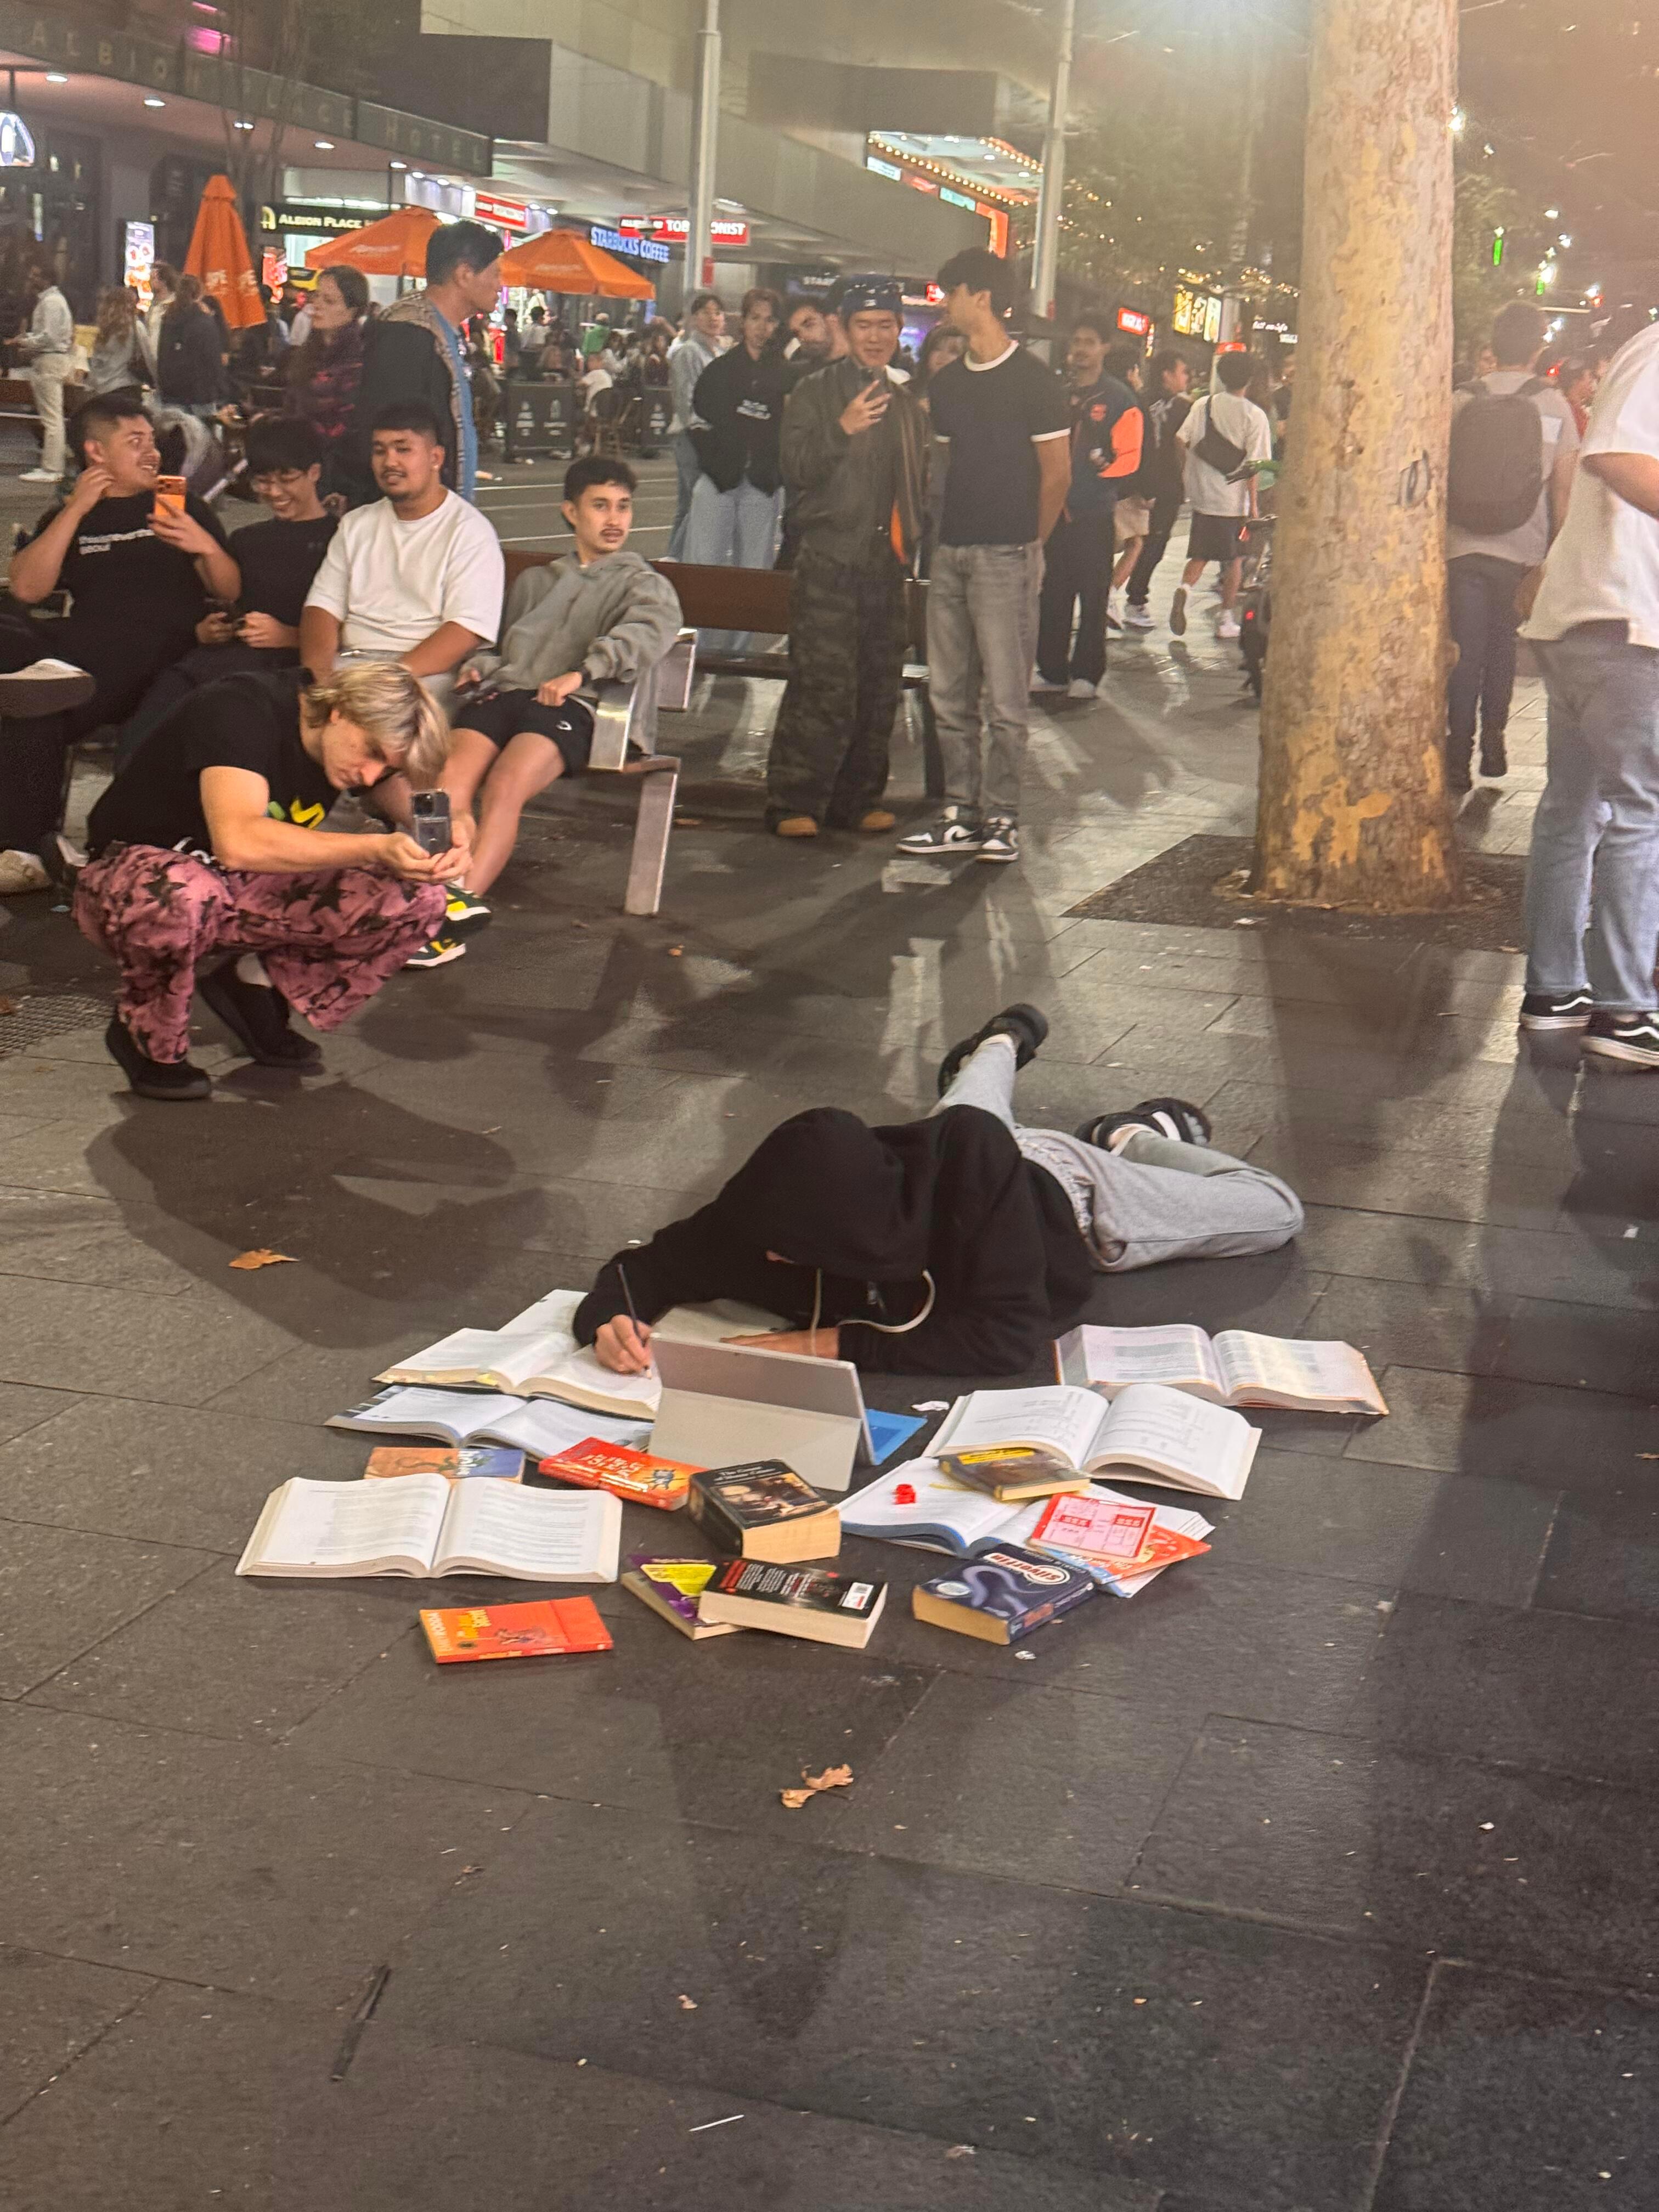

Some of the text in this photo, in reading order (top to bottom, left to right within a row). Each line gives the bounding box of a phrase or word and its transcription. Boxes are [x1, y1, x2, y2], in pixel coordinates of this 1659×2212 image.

[31, 21, 200, 90] ALBION
[386, 114, 483, 164] HOTEL
[279, 213, 321, 226] ALBION
[324, 217, 363, 229] PLACE
[591, 227, 670, 263] STARBUCKS COFFEE
